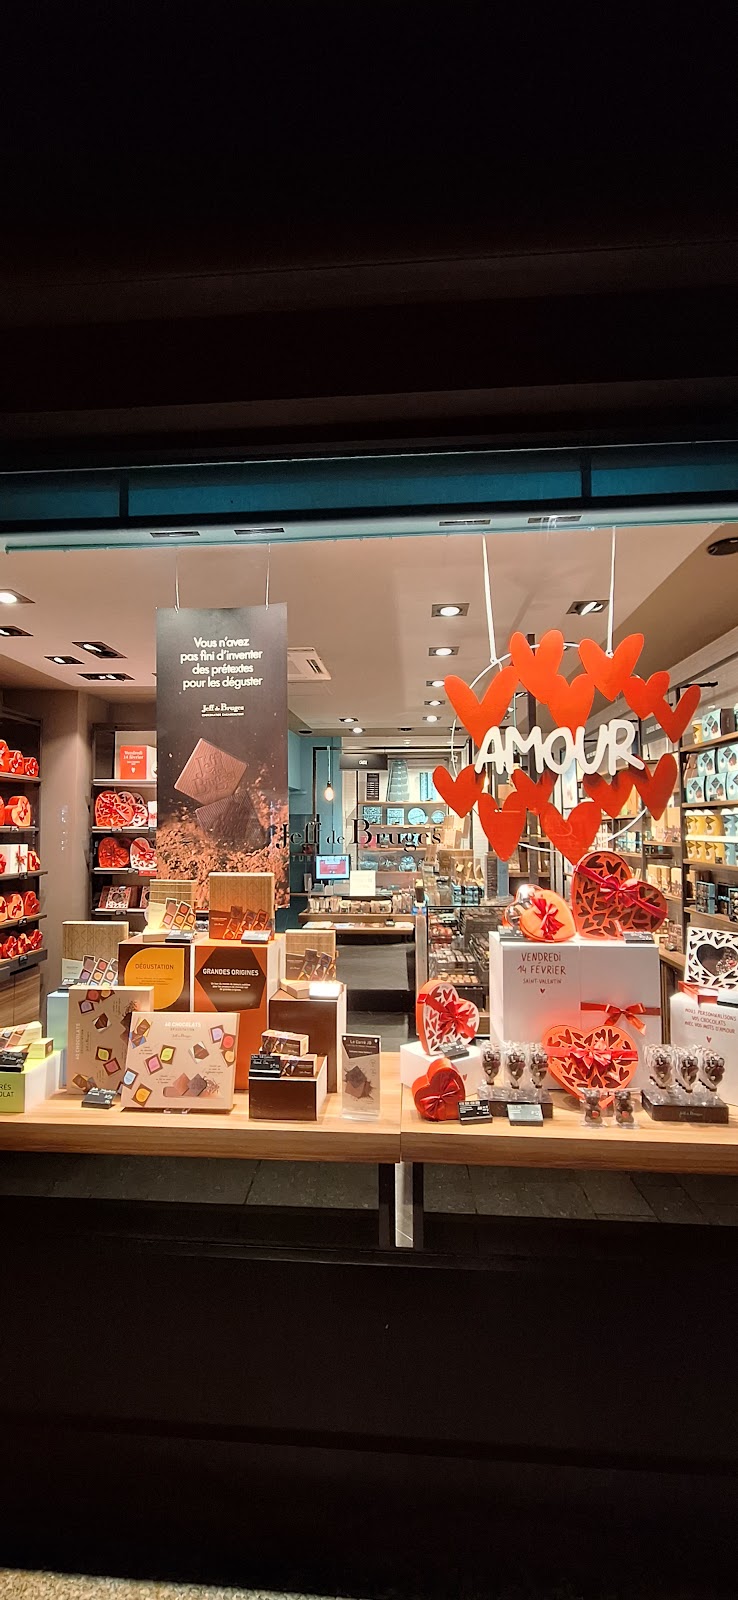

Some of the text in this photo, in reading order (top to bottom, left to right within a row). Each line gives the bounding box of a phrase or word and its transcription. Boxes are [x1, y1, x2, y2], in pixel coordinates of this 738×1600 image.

[193, 636, 250, 649] Vous n'avez
[180, 649, 263, 664] pas fini d'inventer
[191, 663, 254, 677] des prétextes
[182, 675, 263, 691] pour les déguster
[475, 719, 645, 776] AMOUR
[276, 820, 321, 849] Jeff
[326, 830, 345, 845] de
[350, 818, 442, 853] Bruges
[135, 962, 174, 970] DÉGUSTATION
[202, 967, 259, 977] GRANDES ORIGINES
[517, 964, 527, 974] 14
